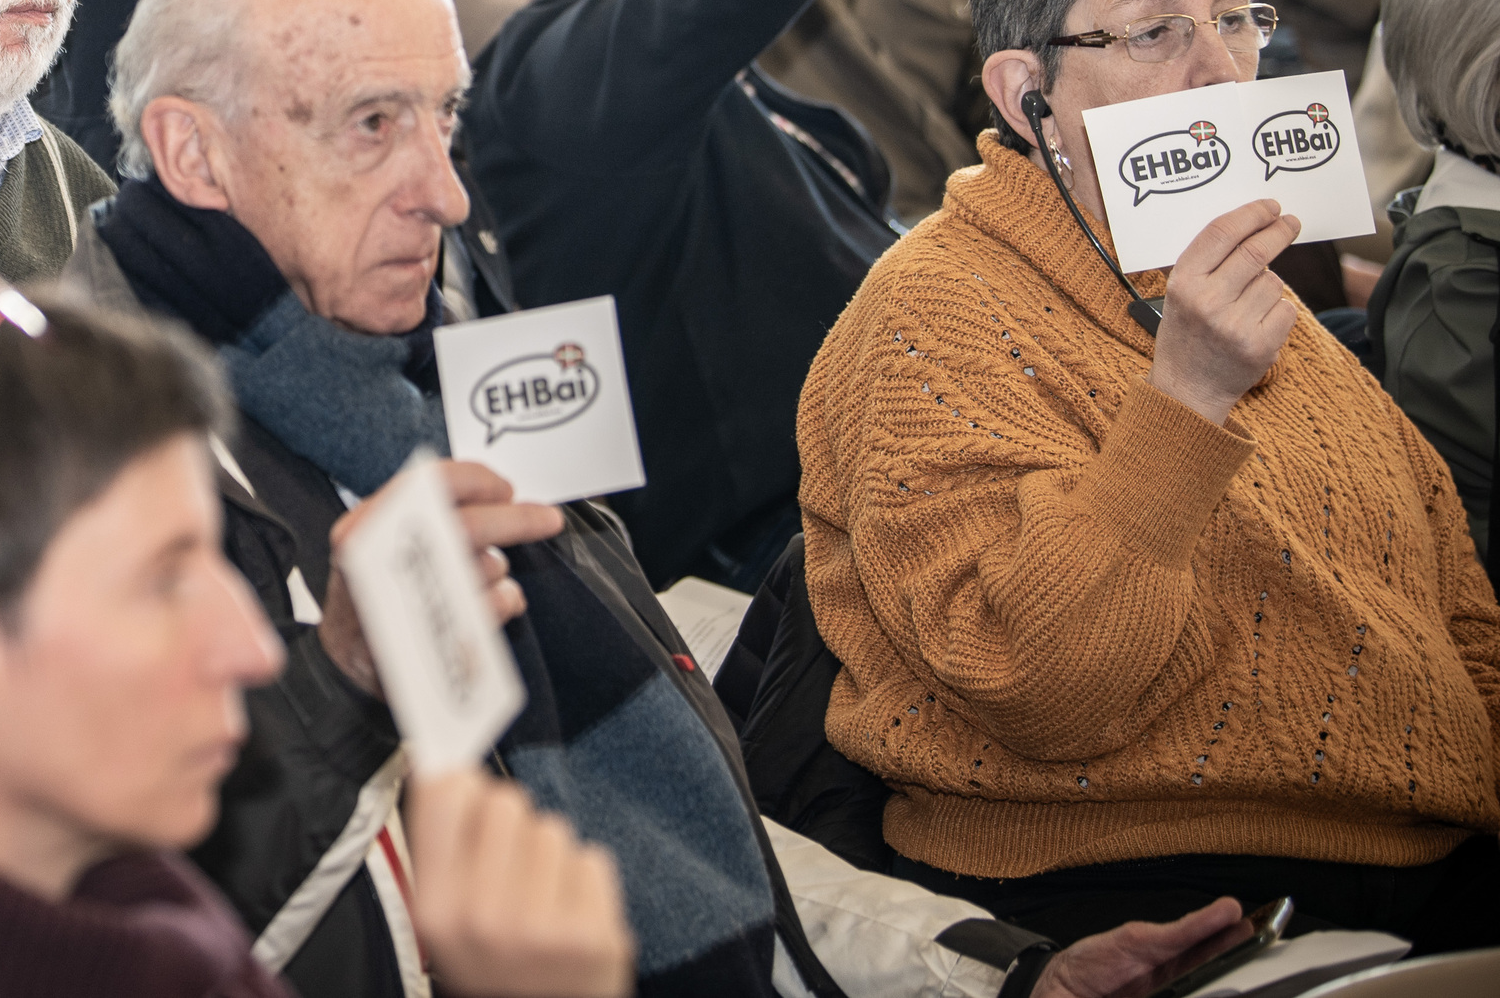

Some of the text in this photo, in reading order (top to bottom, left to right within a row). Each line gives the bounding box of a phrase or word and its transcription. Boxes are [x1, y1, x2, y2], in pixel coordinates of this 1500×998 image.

[1261, 122, 1333, 158] EHBai
[1129, 139, 1221, 183] EHBai
[1160, 174, 1200, 185] www.ehbai.eus
[485, 367, 587, 415] EHBai
